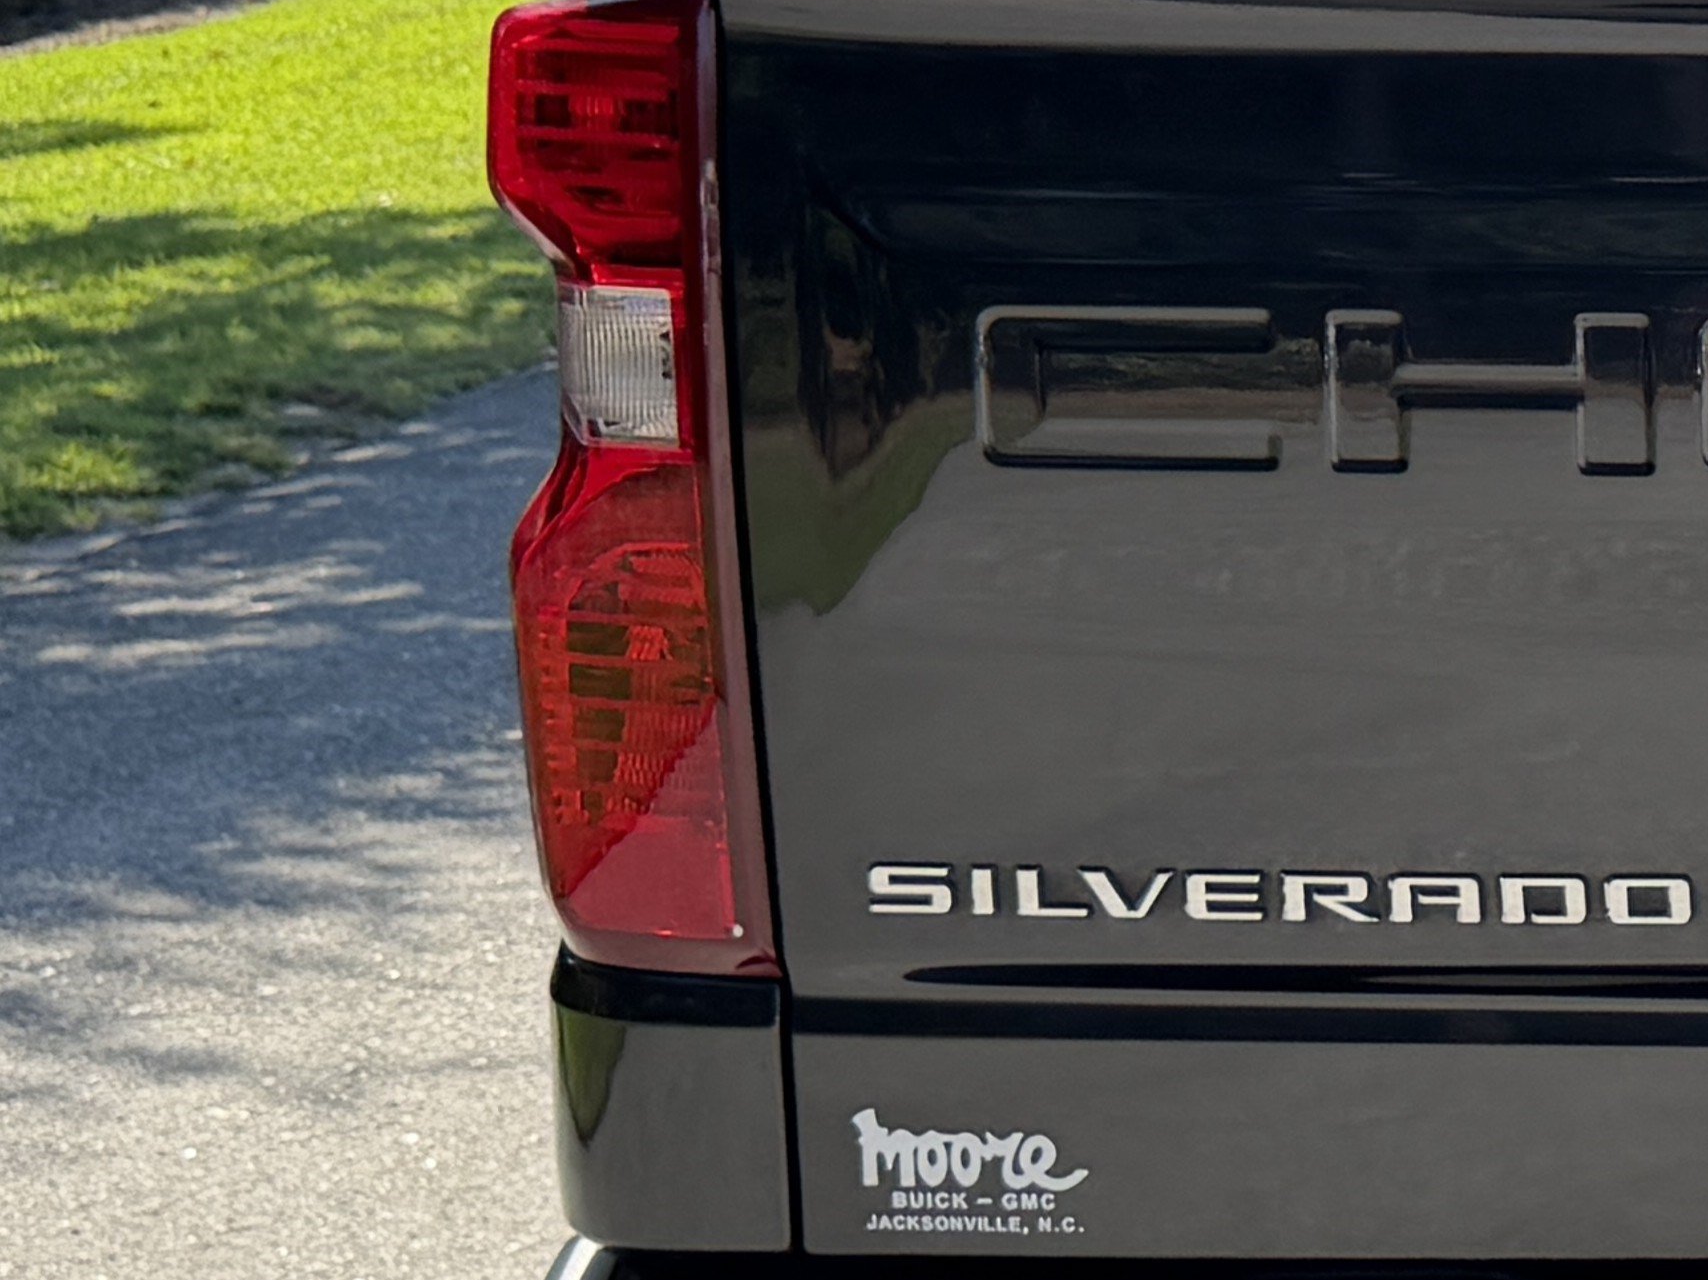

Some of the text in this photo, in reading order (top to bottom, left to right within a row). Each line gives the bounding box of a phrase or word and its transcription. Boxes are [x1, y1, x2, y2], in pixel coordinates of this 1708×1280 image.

[867, 863, 1693, 925] SILVERADO
[891, 1191, 968, 1211] BUICK
[1000, 1193, 1056, 1211] GMC
[865, 1213, 1086, 1235] JACKSONVILLE, N.C.
